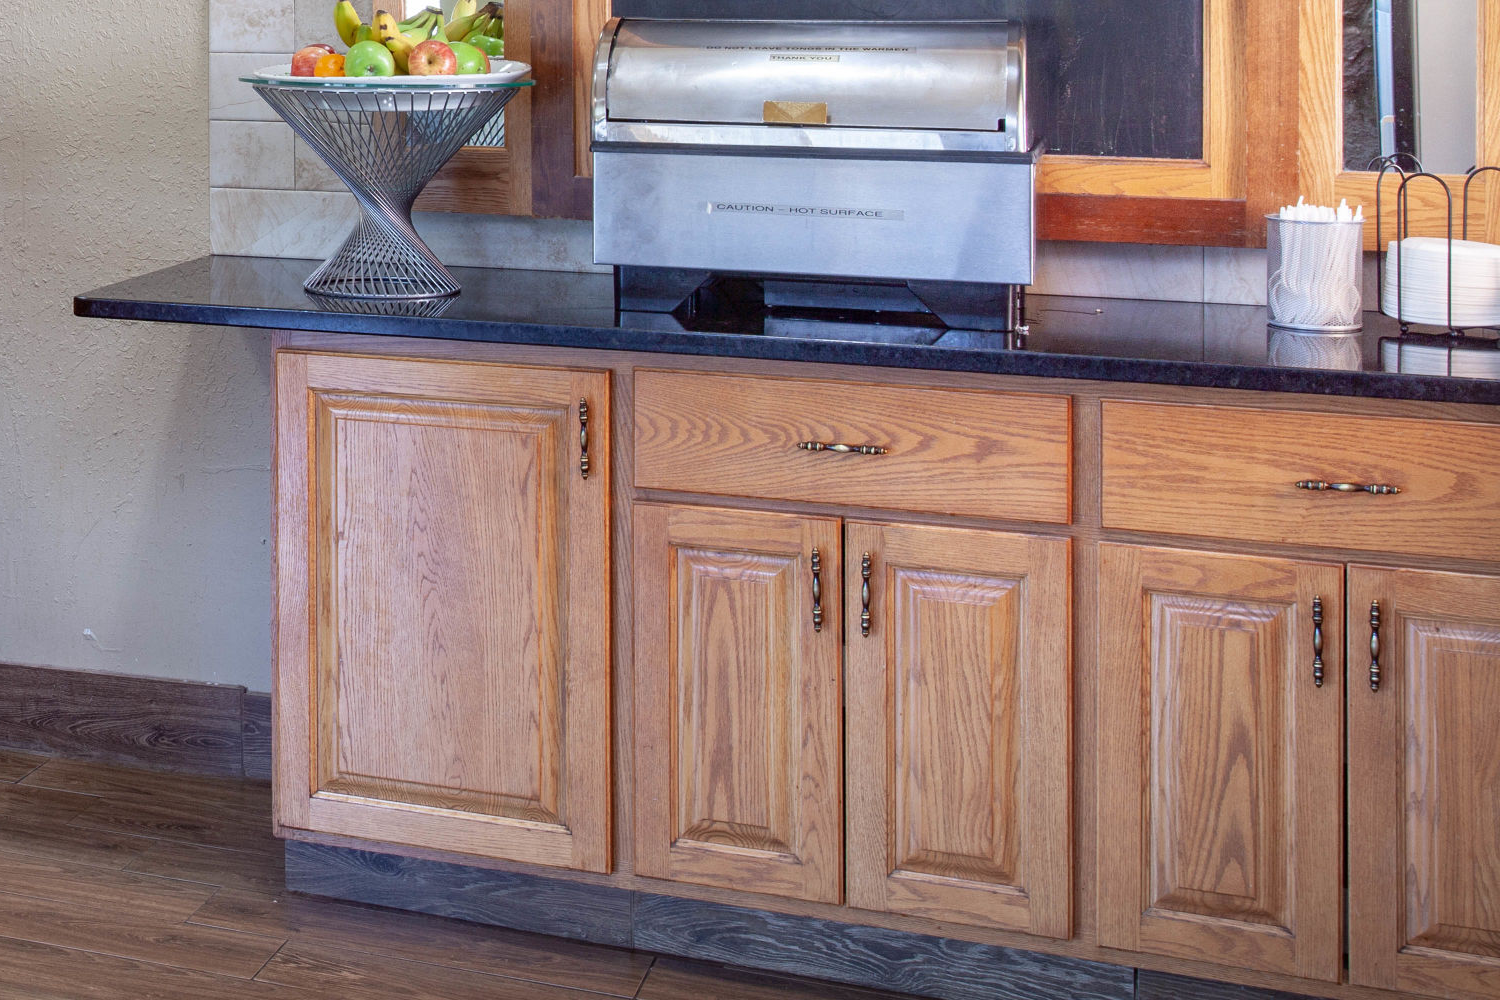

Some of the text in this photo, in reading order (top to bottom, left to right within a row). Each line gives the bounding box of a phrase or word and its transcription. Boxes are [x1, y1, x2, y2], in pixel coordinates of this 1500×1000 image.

[716, 203, 775, 213] CAUTION
[788, 207, 817, 215] HOT
[819, 208, 884, 218] SURFACE
